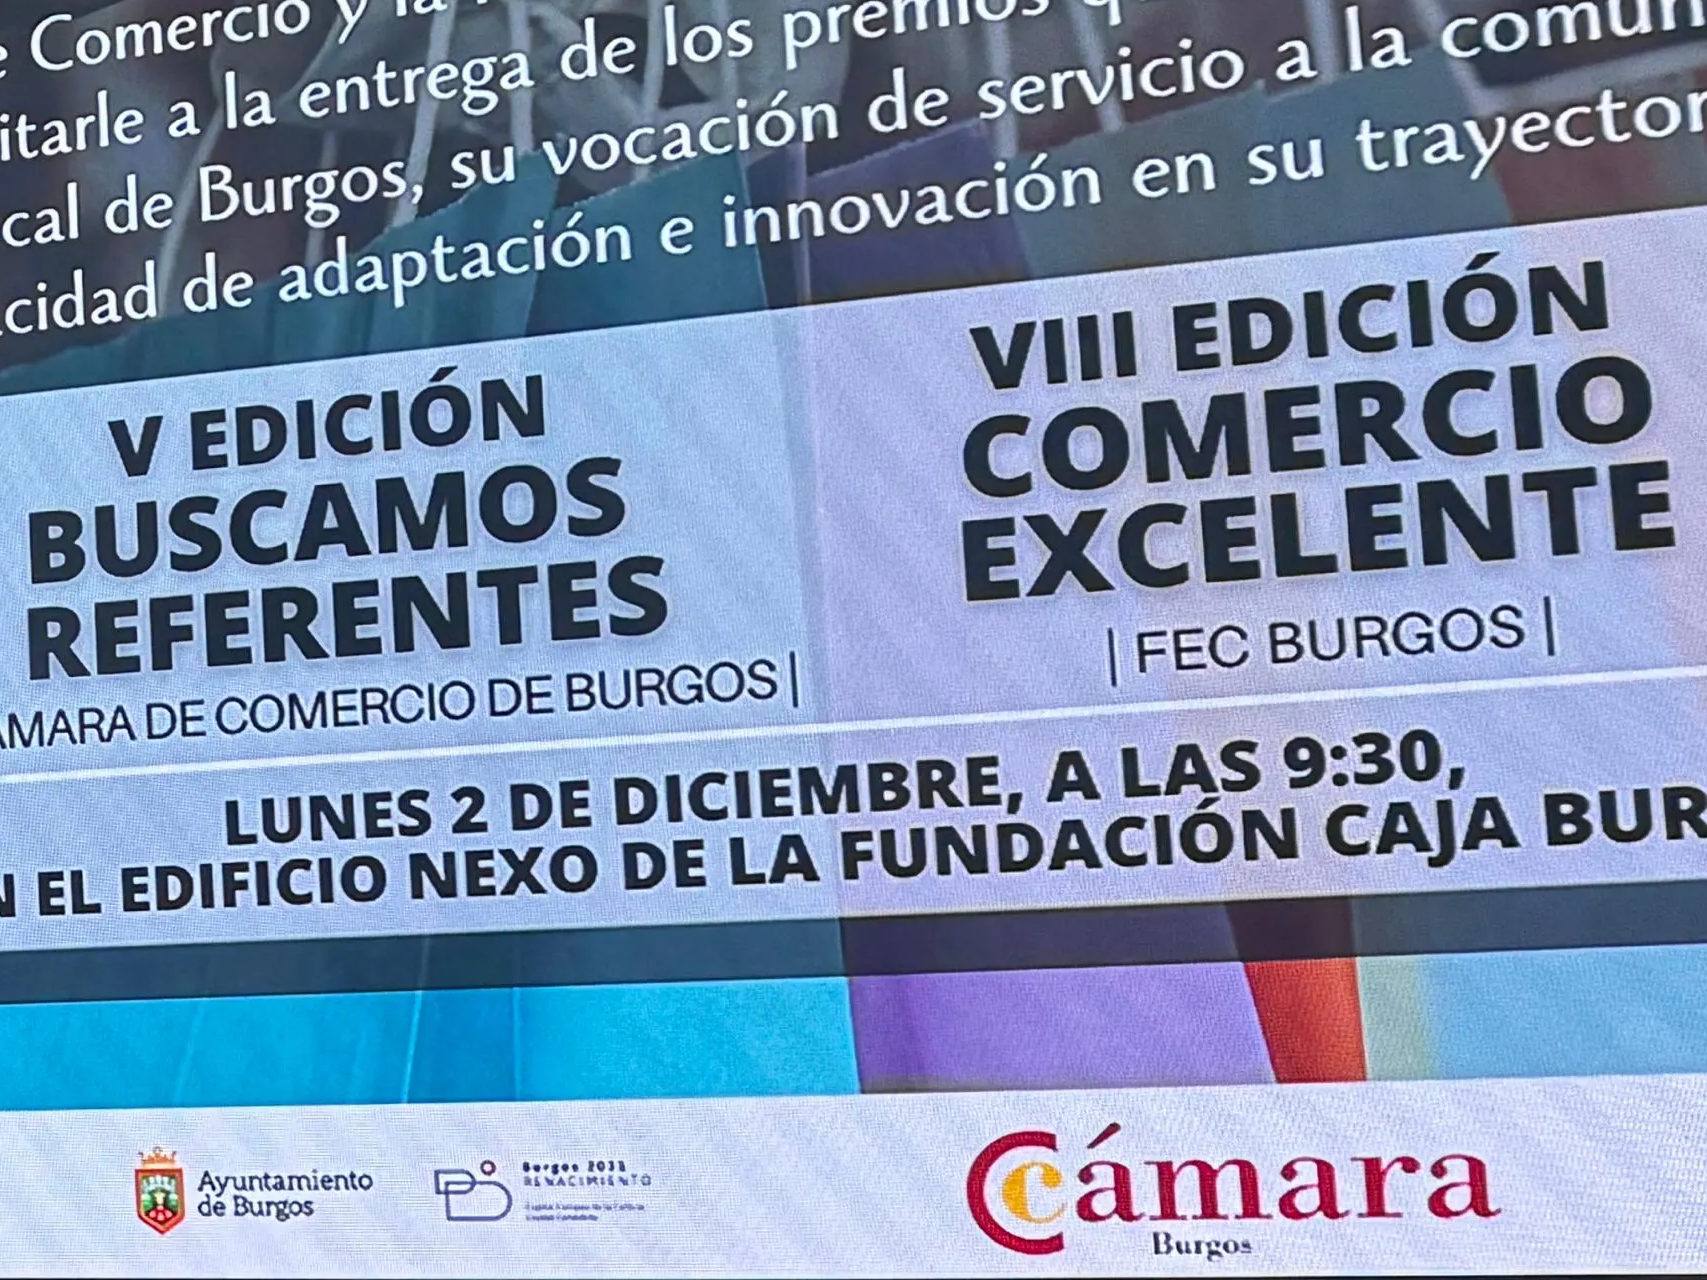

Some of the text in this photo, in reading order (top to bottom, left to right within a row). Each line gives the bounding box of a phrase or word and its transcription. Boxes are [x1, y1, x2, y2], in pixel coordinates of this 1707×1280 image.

[105, 174, 172, 233] de
[200, 162, 422, 228] Burgos,
[452, 147, 514, 188] su
[543, 99, 838, 174] vocación
[868, 68, 948, 132] de
[978, 39, 1243, 118] servicio
[1277, 41, 1317, 80] a
[1346, 6, 1412, 71] la
[169, 102, 200, 137] a
[226, 71, 276, 128] la
[300, 53, 534, 117] entrega
[561, 18, 635, 79] de
[665, 5, 752, 65] los
[184, 252, 253, 312] de
[279, 212, 631, 308] adaptación
[661, 218, 693, 253] e
[724, 153, 1100, 247] innovación
[1133, 153, 1215, 197] en
[1248, 139, 1323, 184] su
[1356, 90, 1707, 179] trayector
[969, 252, 1608, 390] VIII EDICIÓN
[108, 366, 544, 477] V EDICIÓN
[963, 356, 1652, 498] COMERCIO
[29, 457, 625, 584] BUSCAMOS
[962, 461, 1675, 601] EXCELENTE
[28, 556, 667, 680] REFERENTES
[1137, 605, 1524, 673] FEC BURGOS
[146, 699, 206, 739] DE
[215, 681, 475, 735] COMERCIO
[488, 675, 554, 716] DE
[566, 659, 777, 711] BURGOS
[226, 729, 1464, 845] LUNES 2 DE DICIEMBRE, A LAS 9:30,
[38, 870, 101, 916] EL
[121, 856, 386, 912] EDIFICIO
[409, 845, 597, 899] NEXO
[623, 839, 706, 890] DE
[730, 834, 822, 888] LA
[841, 793, 1298, 880] FUNDACIÓN
[1326, 797, 1520, 868] CAJA
[1544, 786, 1707, 846] BUR
[198, 1171, 373, 1197] Ayuntamiento
[198, 1194, 314, 1222] de Burgos
[1153, 1232, 1252, 1261] Burgos
